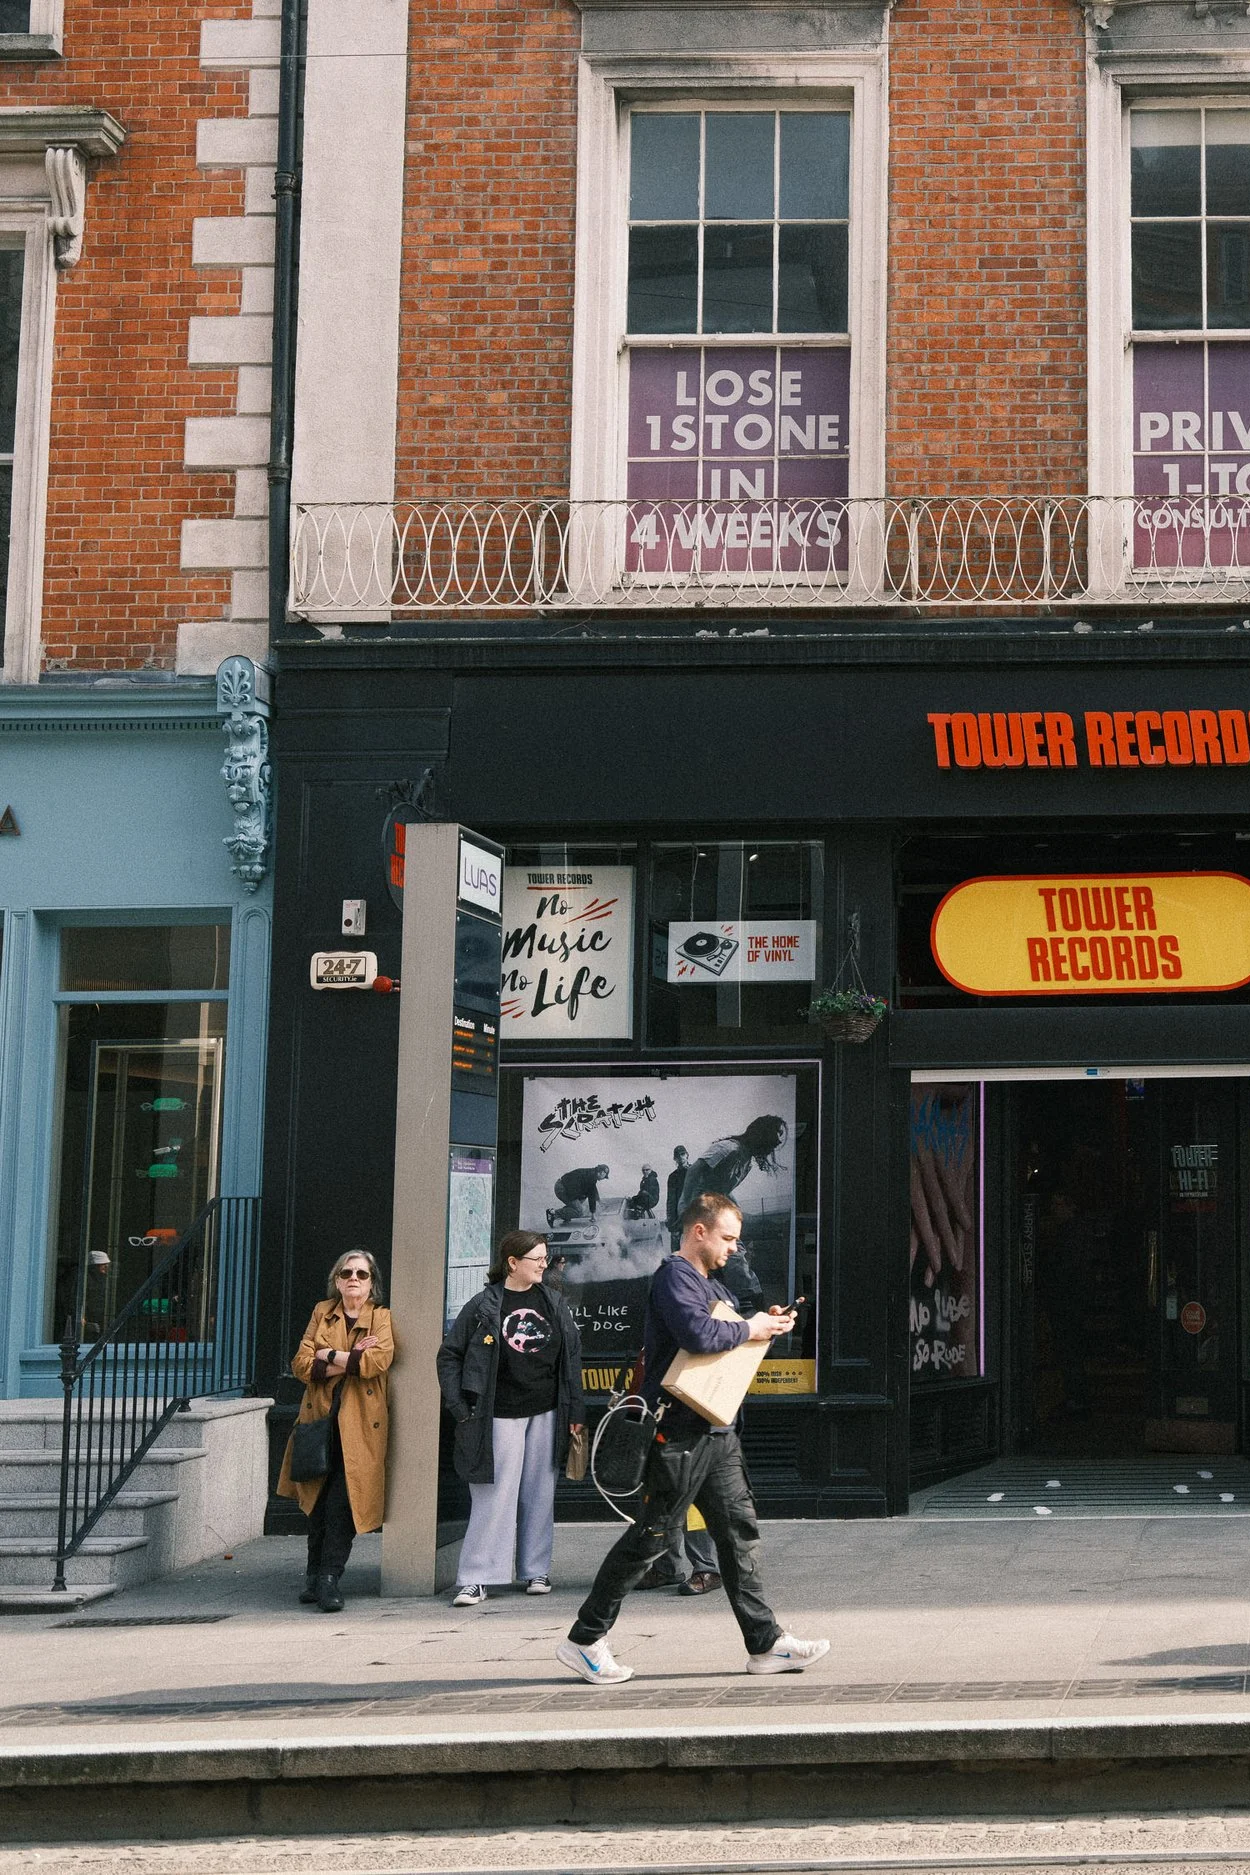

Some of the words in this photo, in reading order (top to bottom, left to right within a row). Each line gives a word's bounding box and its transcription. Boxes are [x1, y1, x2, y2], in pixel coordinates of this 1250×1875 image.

[676, 369, 802, 406] LOSE
[711, 468, 765, 500] IN
[630, 514, 660, 549] 4
[673, 511, 842, 549] WEEKS
[927, 711, 1078, 769] TOWER
[464, 856, 497, 896] LUAS
[527, 873, 555, 885] TOWER
[557, 873, 593, 885] RECORDS
[1038, 886, 1157, 932] TOWER
[502, 923, 613, 963] Music
[747, 936, 768, 949] THE
[772, 935, 800, 949] HOME
[747, 950, 760, 963] OF
[765, 950, 794, 963] VINYL
[1027, 935, 1182, 982] RECORDS
[530, 966, 617, 1021] Life
[555, 1094, 601, 1121] THE
[593, 1320, 631, 1332] DOG
[598, 1304, 629, 1317] LIKE
